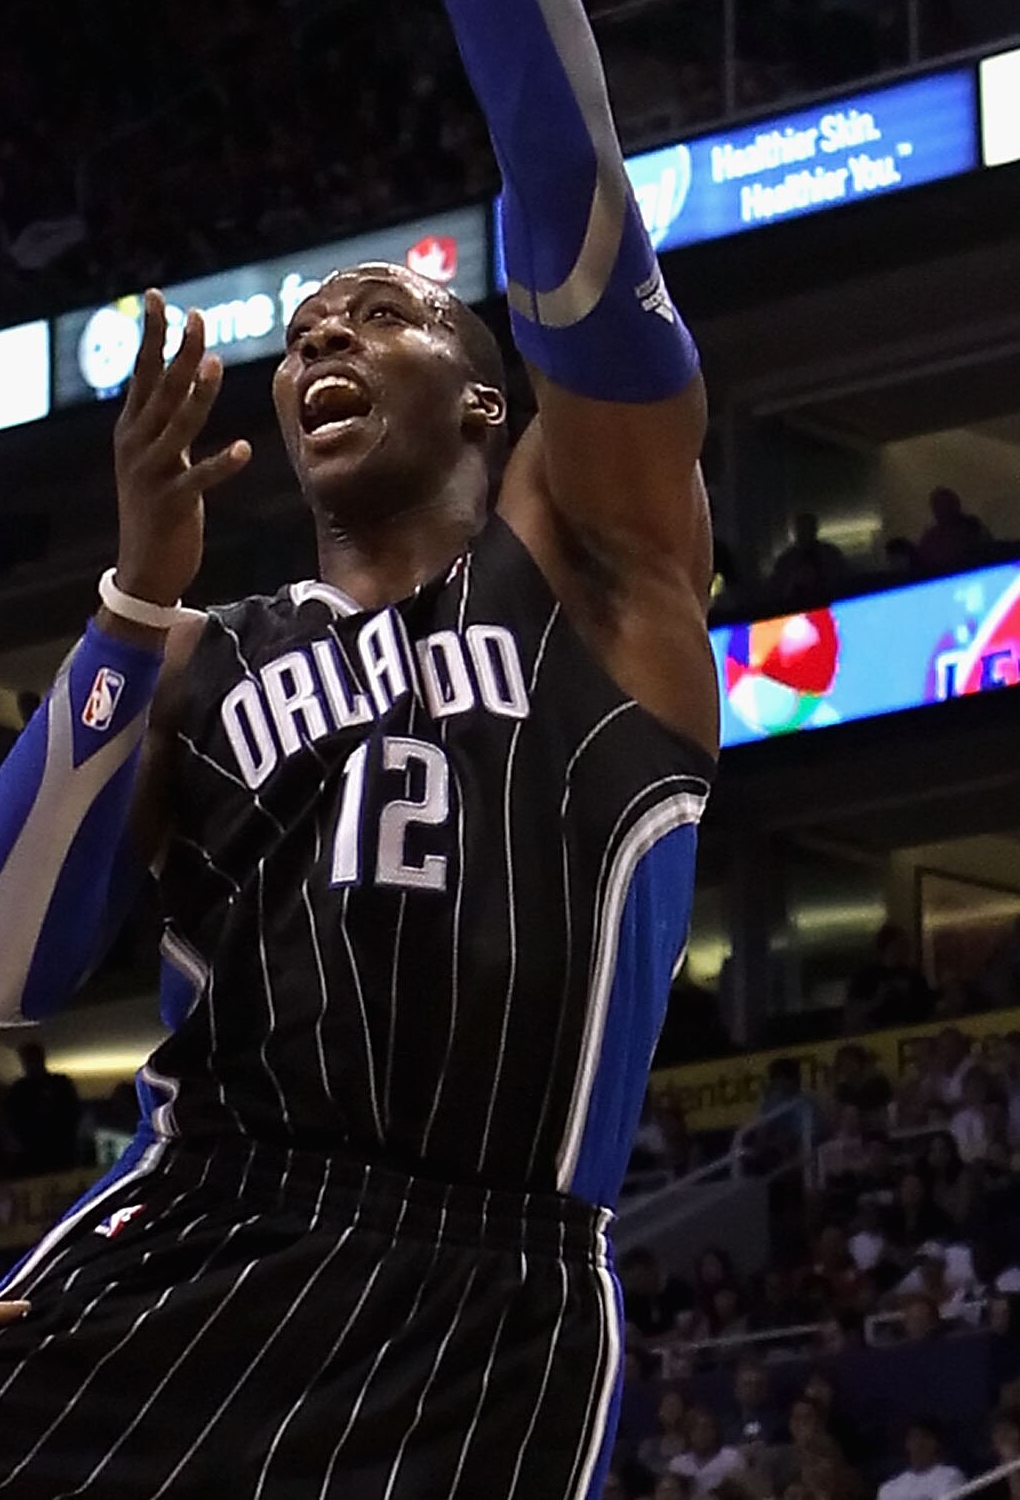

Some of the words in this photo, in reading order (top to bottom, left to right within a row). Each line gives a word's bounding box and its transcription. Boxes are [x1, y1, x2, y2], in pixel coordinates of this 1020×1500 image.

[711, 127, 818, 183] Healthier
[818, 109, 881, 153] Skin.
[740, 166, 848, 222] Healthier
[220, 605, 530, 791] ORLADO
[329, 734, 450, 892] 12
